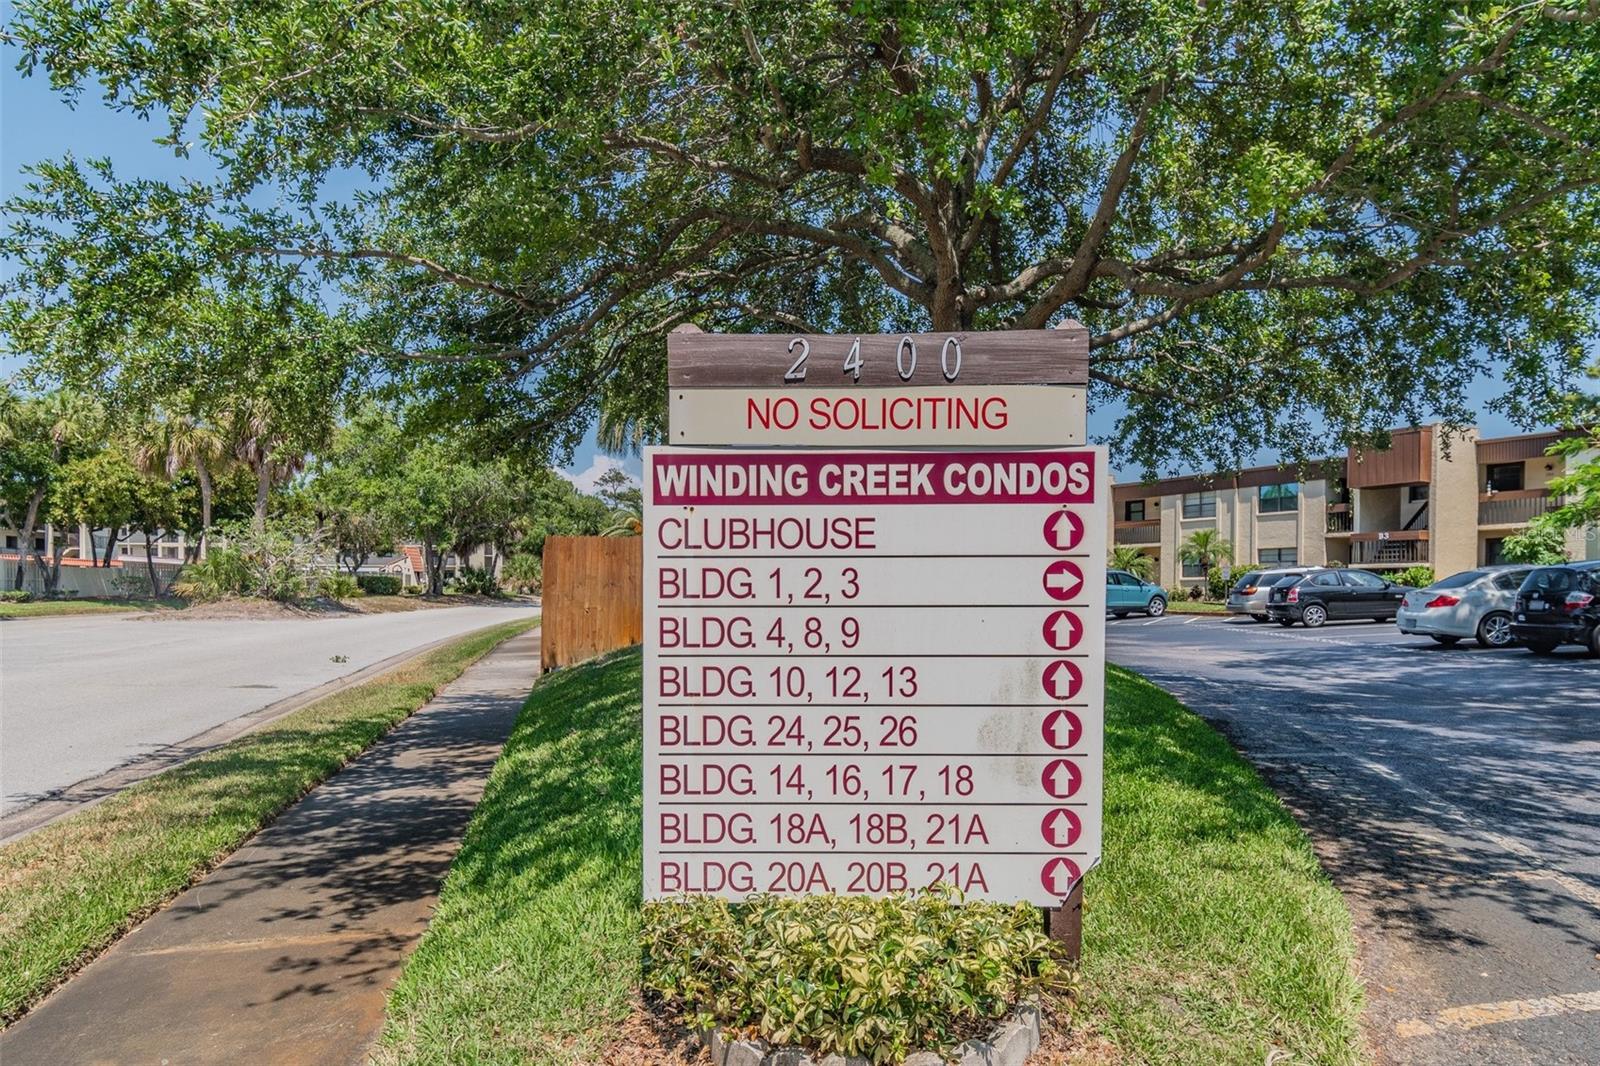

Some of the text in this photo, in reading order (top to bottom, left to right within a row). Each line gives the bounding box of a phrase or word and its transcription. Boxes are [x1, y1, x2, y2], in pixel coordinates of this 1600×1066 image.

[747, 397, 1009, 430] NO SOLICITING
[656, 462, 1090, 497] WINDING CREEK CONDOS
[657, 517, 876, 550] CLUBHOUSE
[658, 567, 860, 604] BLDG. 1, 2, 3
[659, 617, 860, 653] BLDG. 4, 8, 9
[659, 666, 918, 702] BLDG. 10, 12, 13
[659, 715, 918, 751] BLDG. 24, 25, 26
[659, 764, 974, 800] BLDG. 14, 16, 17, 18
[660, 813, 989, 849] BLDG. 18A, 18B, 21A
[660, 861, 989, 897] BLDG. 20A, 20B, 21A
